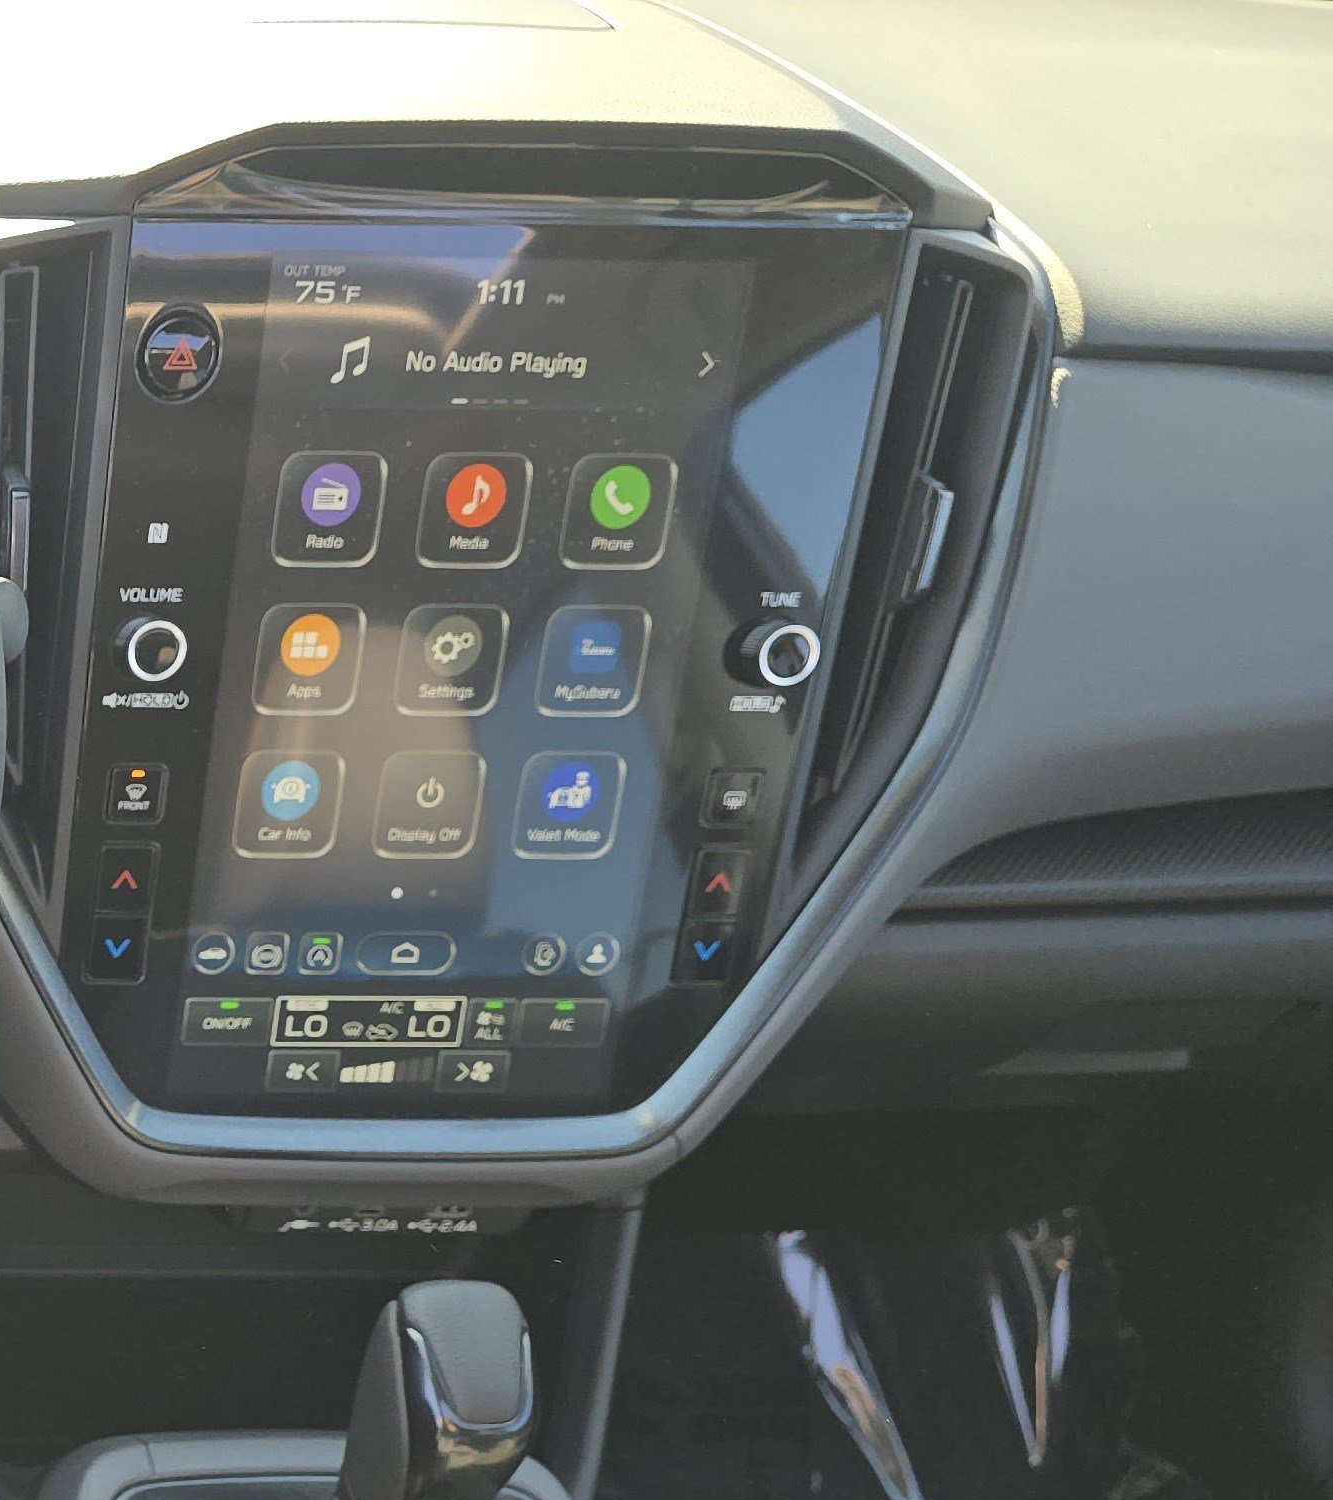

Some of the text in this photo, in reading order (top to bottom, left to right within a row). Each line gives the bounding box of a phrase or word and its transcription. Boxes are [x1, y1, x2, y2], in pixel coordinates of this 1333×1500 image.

[477, 279, 526, 305] 1:11
[405, 351, 588, 379] No Audio Playing
[306, 534, 344, 549] Radio
[449, 536, 489, 550] Media
[591, 537, 634, 551] Phone
[119, 587, 184, 603] VOLUME
[760, 591, 803, 608] TUNE
[287, 684, 322, 698] Apps
[419, 684, 475, 701] Settings
[257, 827, 311, 841] Car Info
[387, 827, 463, 844] Display Off
[285, 1014, 328, 1038] LO
[407, 1015, 451, 1038] LO
